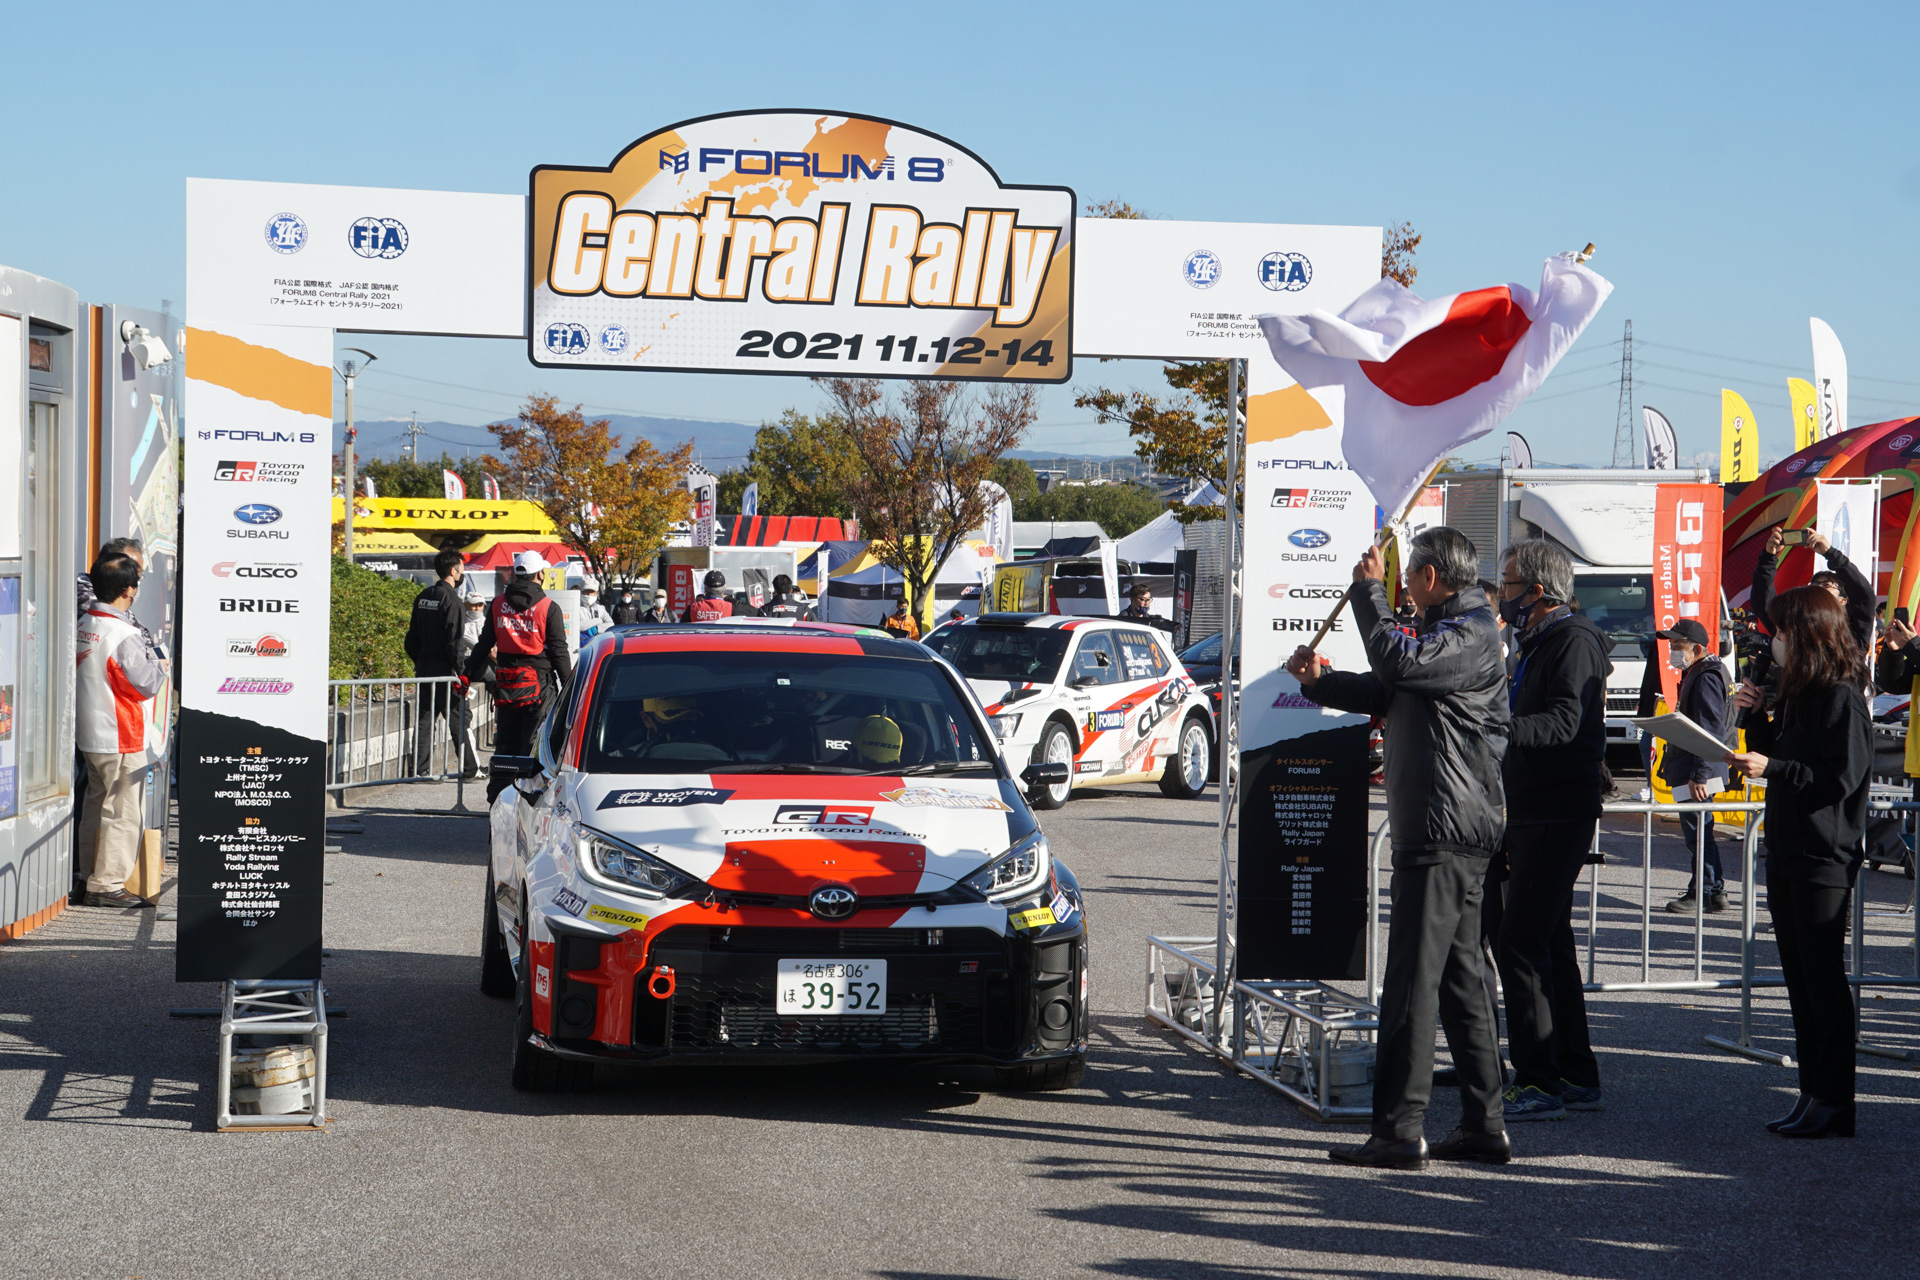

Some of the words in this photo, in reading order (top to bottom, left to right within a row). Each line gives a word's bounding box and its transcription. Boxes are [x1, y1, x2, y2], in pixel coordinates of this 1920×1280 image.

[699, 148, 895, 180] FORUM
[907, 157, 944, 183] 8
[549, 191, 849, 304] Central
[857, 203, 1061, 326] Rally
[274, 279, 301, 287] FIA公認
[303, 280, 332, 288] 国際格式
[339, 281, 368, 290] JAF公認
[371, 283, 399, 291] 国内格式
[282, 289, 317, 297] FORUM8
[319, 290, 347, 298] Central
[349, 292, 368, 300] Rally
[371, 292, 391, 300] 2021
[1230, 322, 1256, 330] Central
[736, 329, 872, 361] 2021
[875, 333, 1055, 367] 11.12-14
[214, 429, 295, 443] FORUM
[299, 432, 315, 443] 8
[260, 462, 305, 470] TOYOTA
[1271, 459, 1343, 470] FORUM
[215, 467, 254, 481] GR
[257, 475, 298, 484] Racing
[1312, 488, 1352, 496] TOYOTA
[1272, 495, 1306, 508] GR
[1310, 495, 1347, 503] GAZOO
[1308, 502, 1345, 511] Racing
[381, 508, 510, 520] DUNLOP
[226, 529, 290, 540] SUBARU
[1281, 553, 1337, 562] SUBARU
[235, 567, 298, 578] CUSCO
[1288, 588, 1344, 599] CUSCO
[218, 598, 300, 613] BRIDE
[501, 602, 537, 617] SATY
[696, 610, 724, 620] SAFETY
[497, 617, 539, 633] MARSHAL
[78, 630, 100, 643] TOYOTA
[229, 645, 257, 656] Rally
[257, 645, 287, 656] Japan
[1151, 642, 1162, 669] 3
[217, 677, 295, 694] LIFEGUARD
[1089, 711, 1096, 733] 3
[239, 764, 269, 772] (TMSC)
[242, 782, 266, 790] (JAC)
[214, 791, 248, 799] NPO法人
[250, 791, 292, 799] M.O.S.C.O.
[656, 789, 719, 797] WOVEN
[235, 799, 272, 807] (MOSCO)
[651, 796, 689, 804] CITY
[776, 810, 871, 826] GR
[720, 827, 794, 836] TOYOTA
[798, 826, 864, 835] GAZOO
[867, 827, 928, 840] Racing
[1281, 829, 1300, 837] Rally
[1302, 830, 1325, 838] Japan
[226, 854, 247, 862] Rally
[248, 853, 278, 861] Stream
[224, 863, 246, 871] Yoda
[247, 863, 280, 872] Rallying
[1281, 865, 1300, 873] Rally
[1301, 865, 1324, 873] Japan
[239, 872, 264, 880] LUCK
[597, 910, 643, 924] DUNLOP
[1021, 912, 1050, 924] DUNLOP
[783, 988, 797, 1003] ほ
[801, 982, 880, 1010] 39-52
